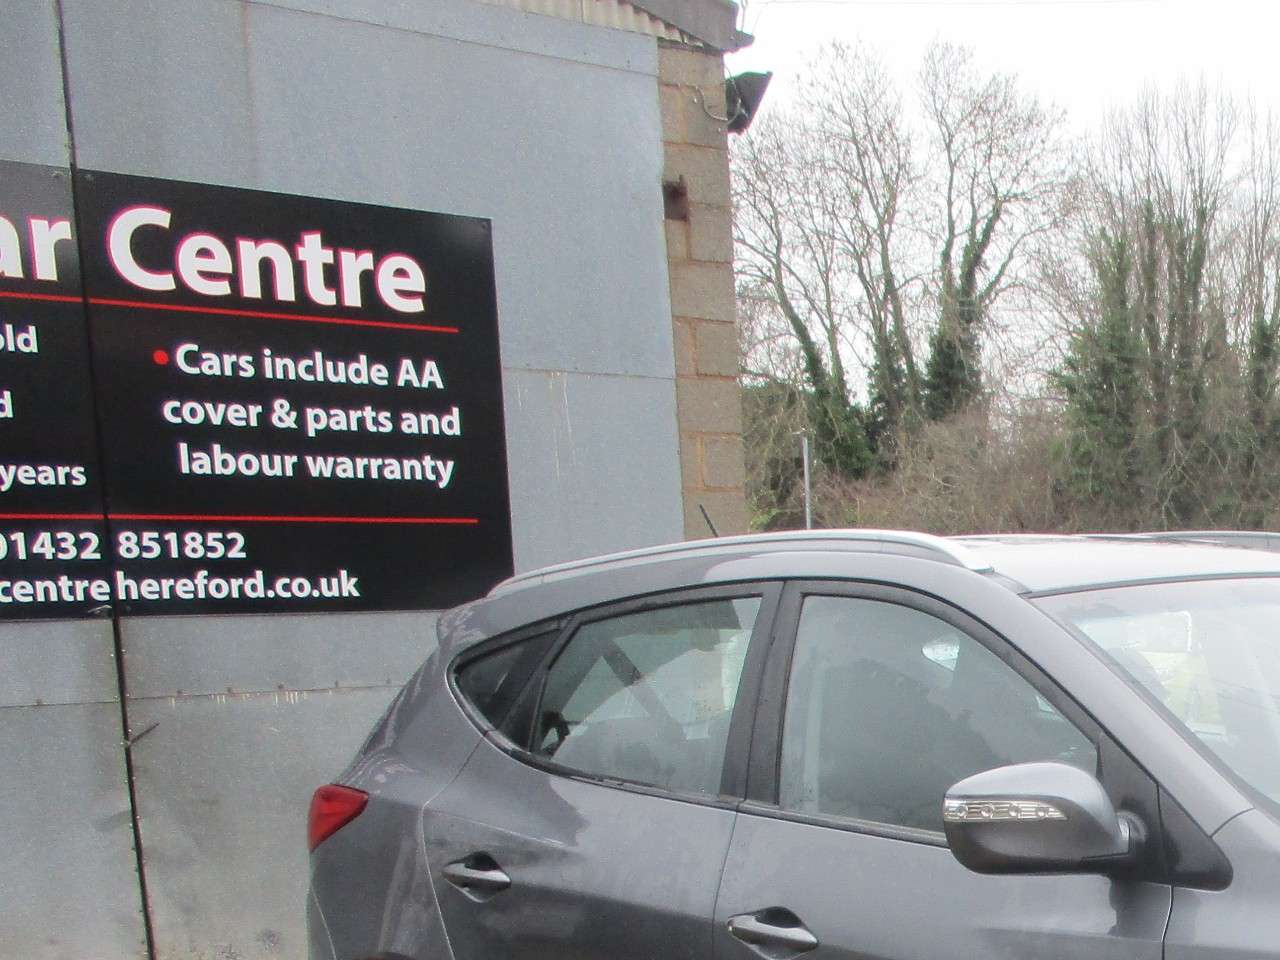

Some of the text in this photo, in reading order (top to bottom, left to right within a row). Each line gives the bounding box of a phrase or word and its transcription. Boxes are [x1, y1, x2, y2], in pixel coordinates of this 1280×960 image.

[107, 206, 426, 313] Centre
[175, 343, 445, 389] Cars include AA
[162, 398, 461, 437] cover & parts and
[179, 442, 455, 488] labour warranty
[117, 530, 247, 559] 851852
